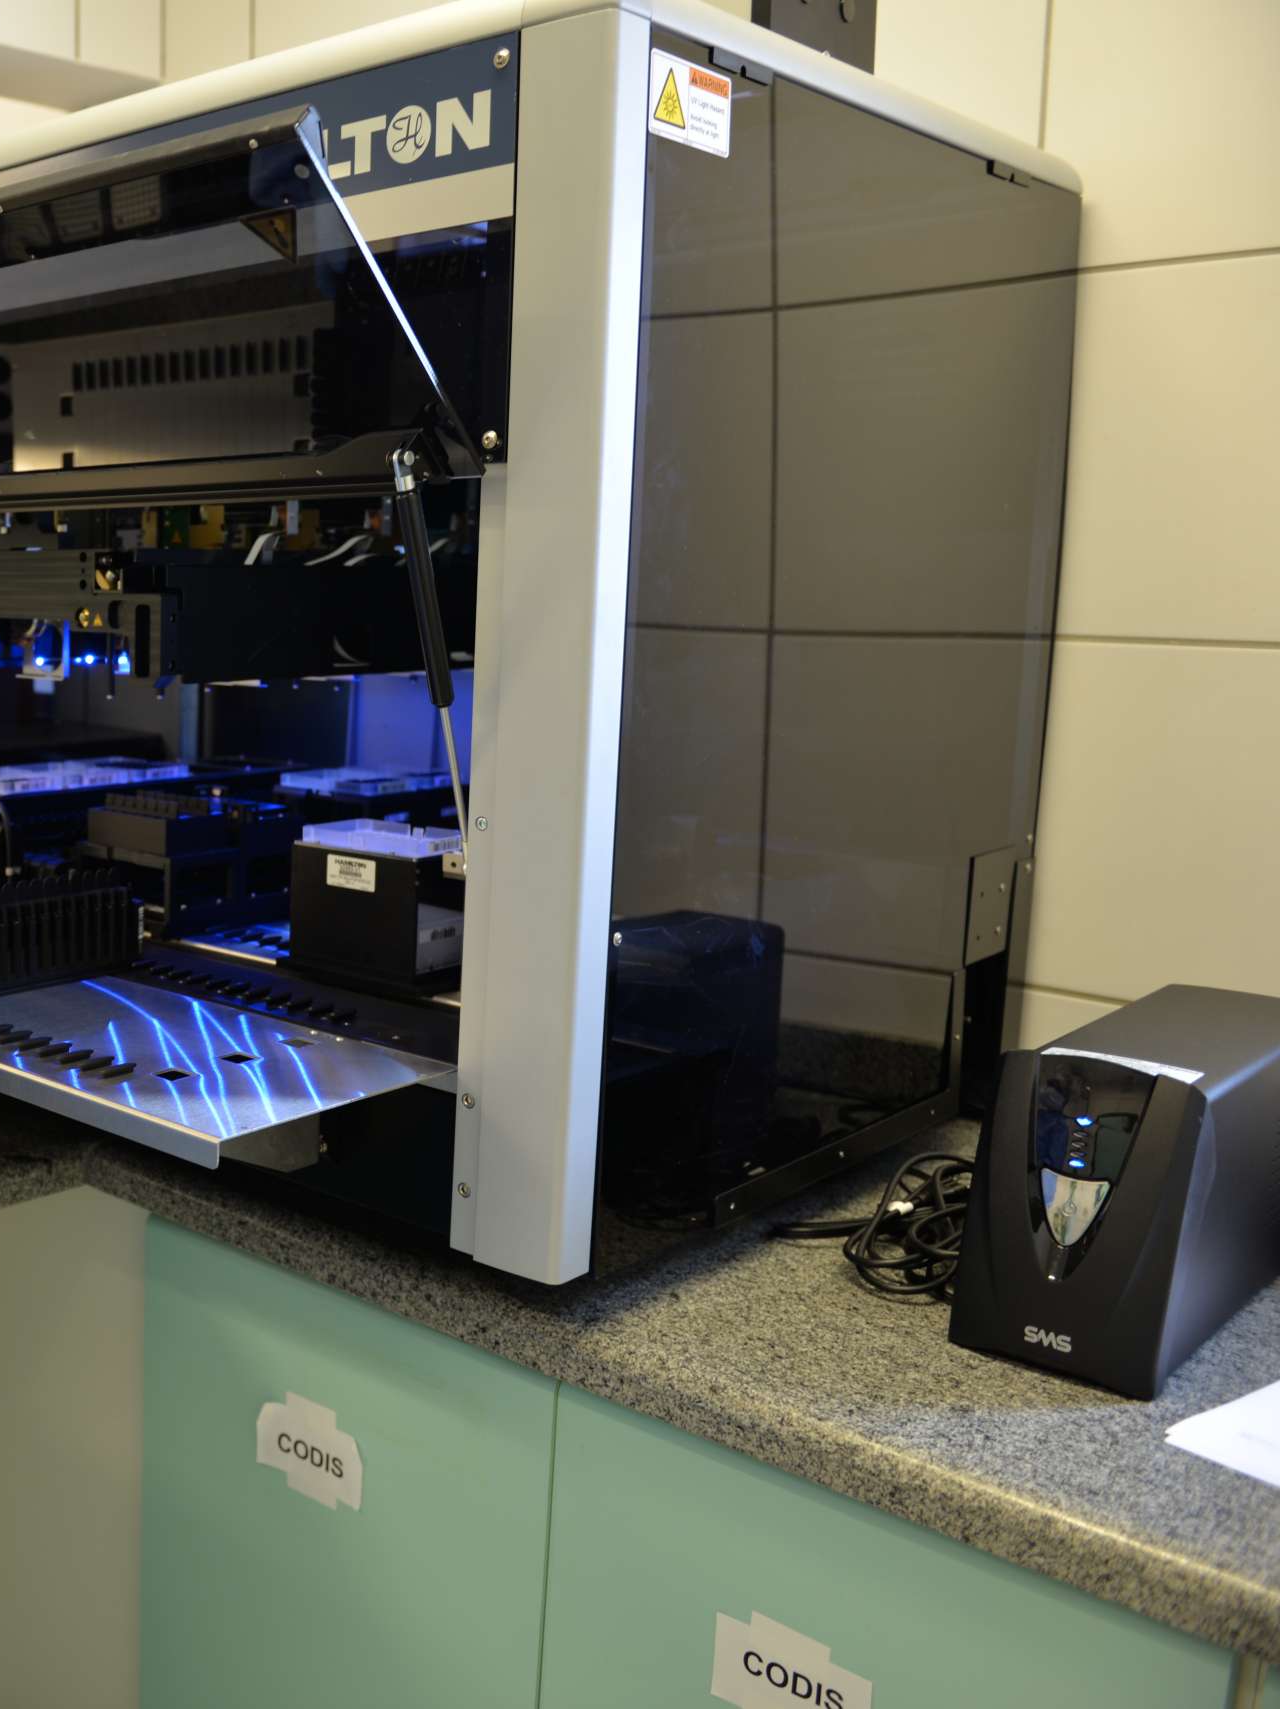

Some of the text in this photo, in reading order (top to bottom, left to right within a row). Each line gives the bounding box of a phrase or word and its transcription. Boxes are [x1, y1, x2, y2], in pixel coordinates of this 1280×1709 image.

[698, 76, 728, 97] WARNING
[323, 89, 492, 180] LTON
[1023, 1325, 1072, 1353] SMS
[277, 1432, 344, 1478] CODIS
[743, 1650, 845, 1709] CODIS
